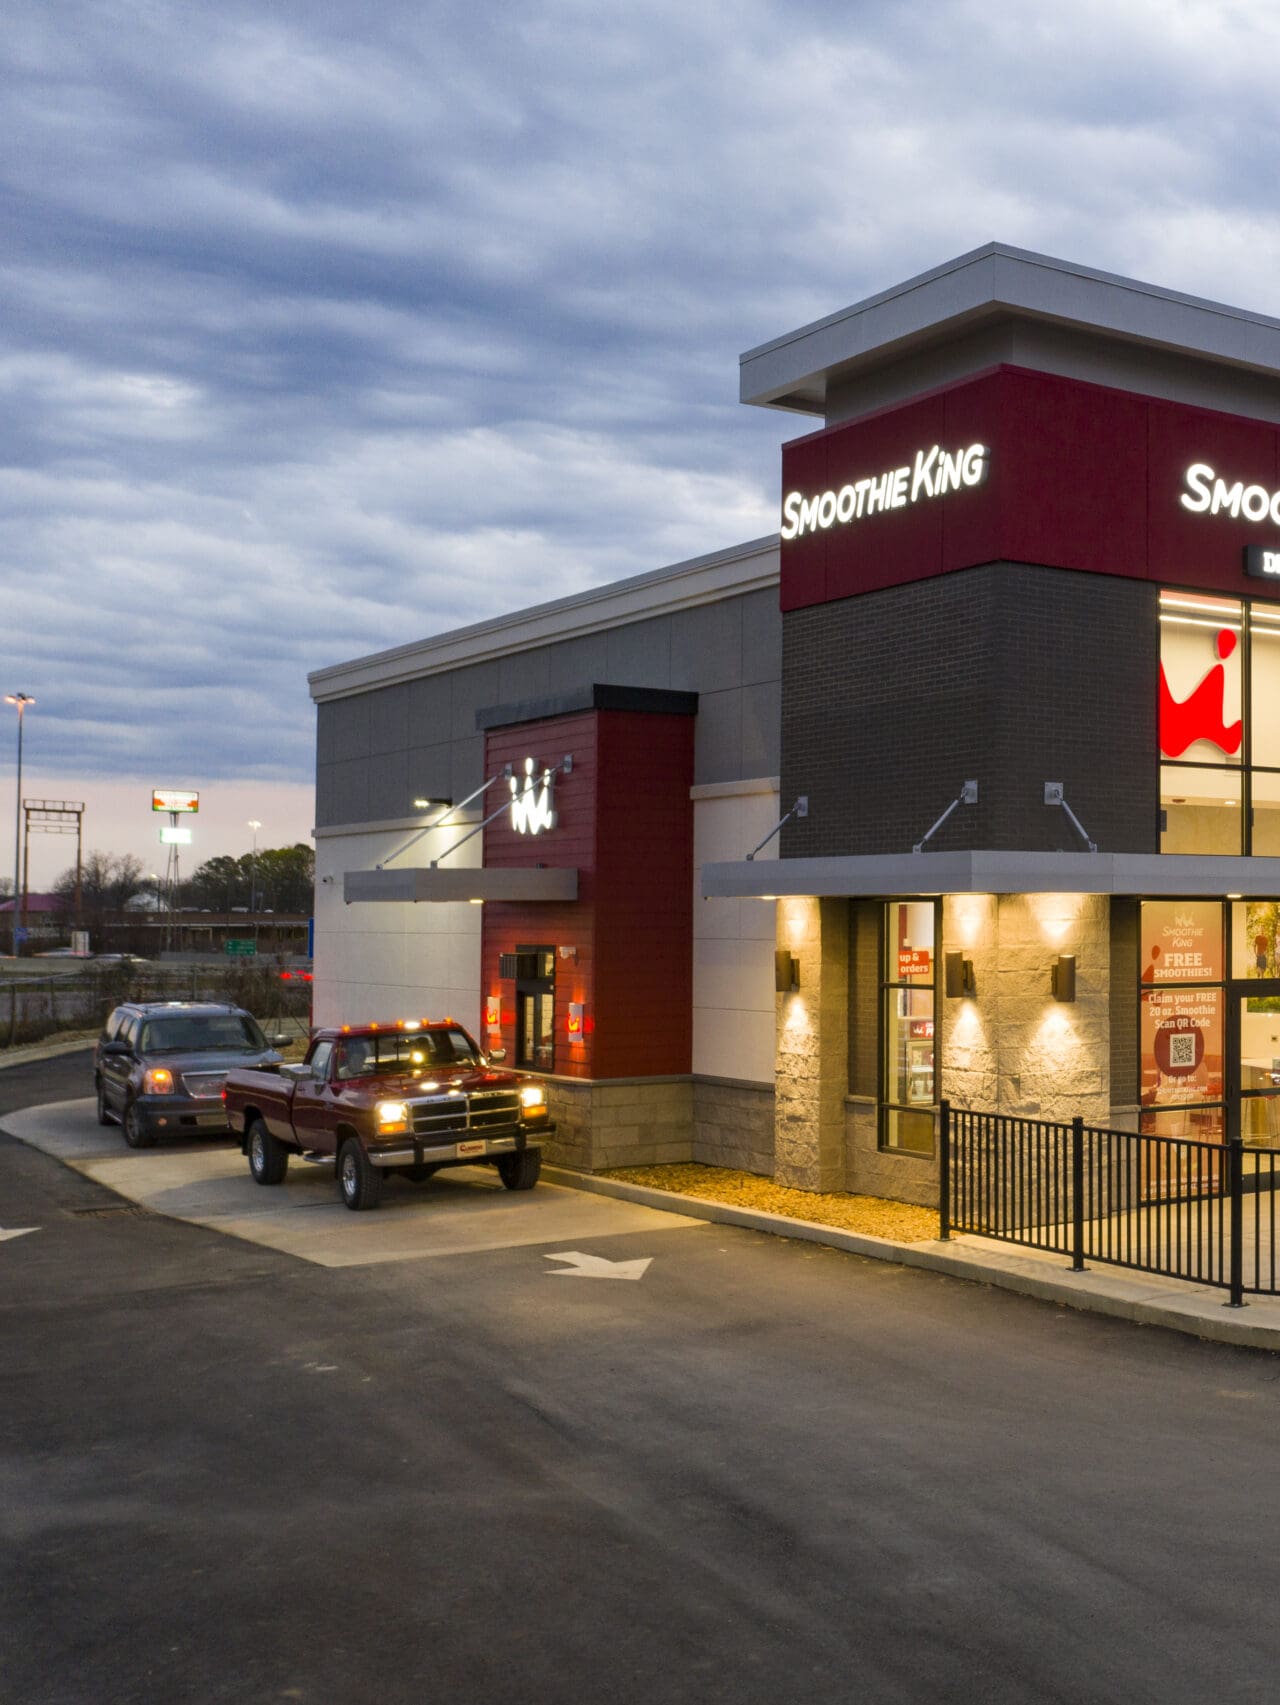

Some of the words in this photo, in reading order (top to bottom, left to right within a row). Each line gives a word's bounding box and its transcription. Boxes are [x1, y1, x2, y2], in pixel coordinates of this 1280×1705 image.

[781, 467, 910, 540] SMOOTHIE
[1162, 926, 1204, 937] SMOOTHIE
[900, 954, 911, 963] up
[912, 953, 919, 961] &
[1164, 953, 1202, 967] FREE
[901, 964, 928, 973] orders
[1154, 967, 1213, 978] SMOOTHIES!
[1148, 993, 1173, 1004] Claim
[1174, 994, 1195, 1005] your
[1196, 992, 1217, 1002] FREE
[1149, 1007, 1161, 1017] 20
[1163, 1007, 1174, 1016] oz.
[1175, 1005, 1216, 1015] Smoothie
[1155, 1019, 1176, 1029] Scan
[1176, 1019, 1189, 1030] QR
[1190, 1018, 1211, 1028] Code
[1168, 1075, 1177, 1083] Or
